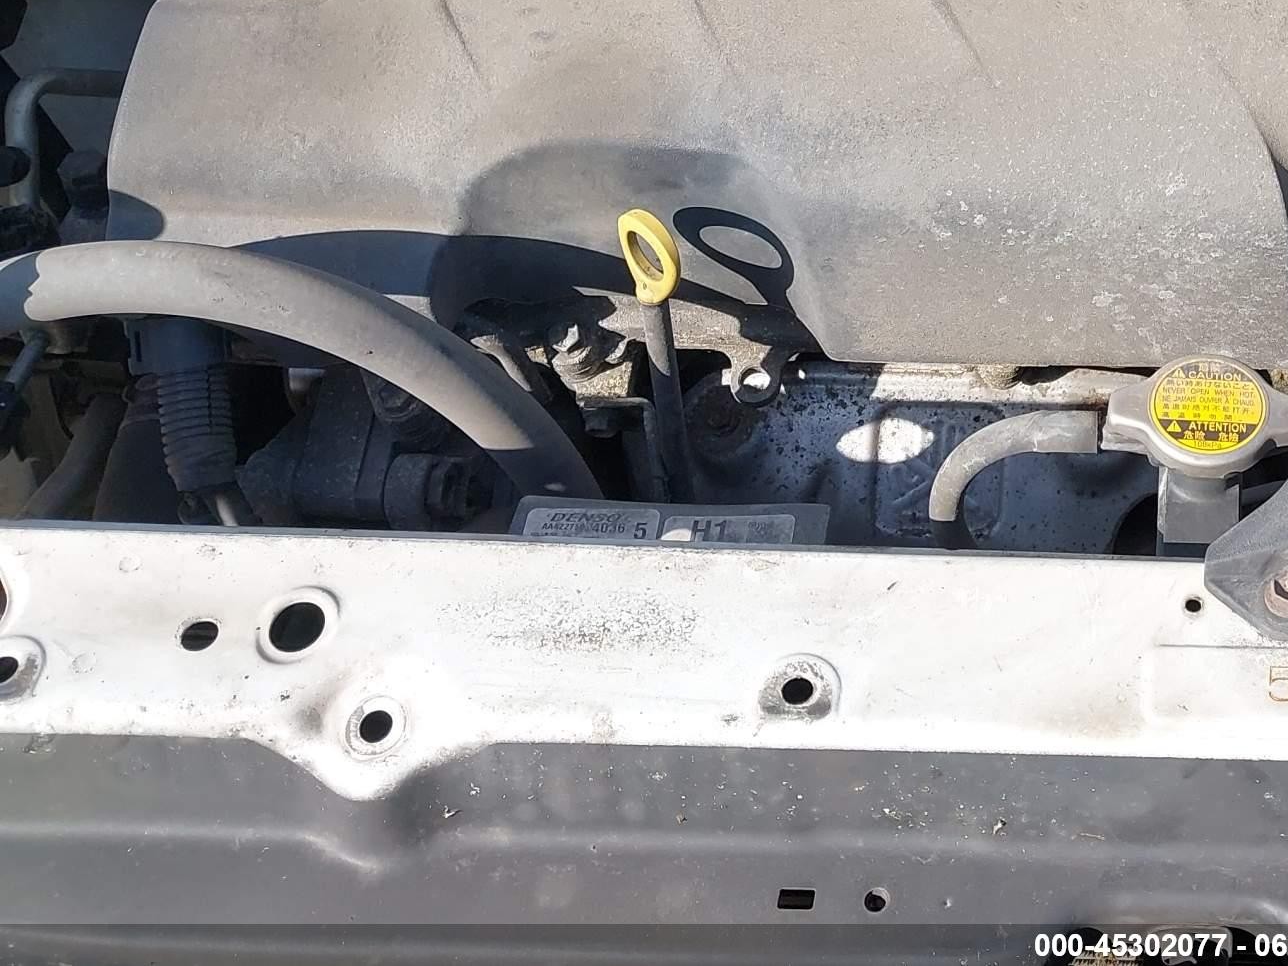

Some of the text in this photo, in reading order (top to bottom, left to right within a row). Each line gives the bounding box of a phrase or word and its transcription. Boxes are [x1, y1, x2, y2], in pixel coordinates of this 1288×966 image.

[1188, 370, 1241, 381] CAUTION
[1163, 386, 1186, 395] NEVER
[1190, 387, 1210, 395] OPEN
[1214, 388, 1235, 396] WHEN
[1162, 394, 1172, 402] NE
[1173, 395, 1197, 403] JAMAIS
[1188, 421, 1247, 433] ATTENTION
[549, 511, 622, 524] DENSO
[633, 521, 648, 540] 5
[690, 519, 728, 542] H1
